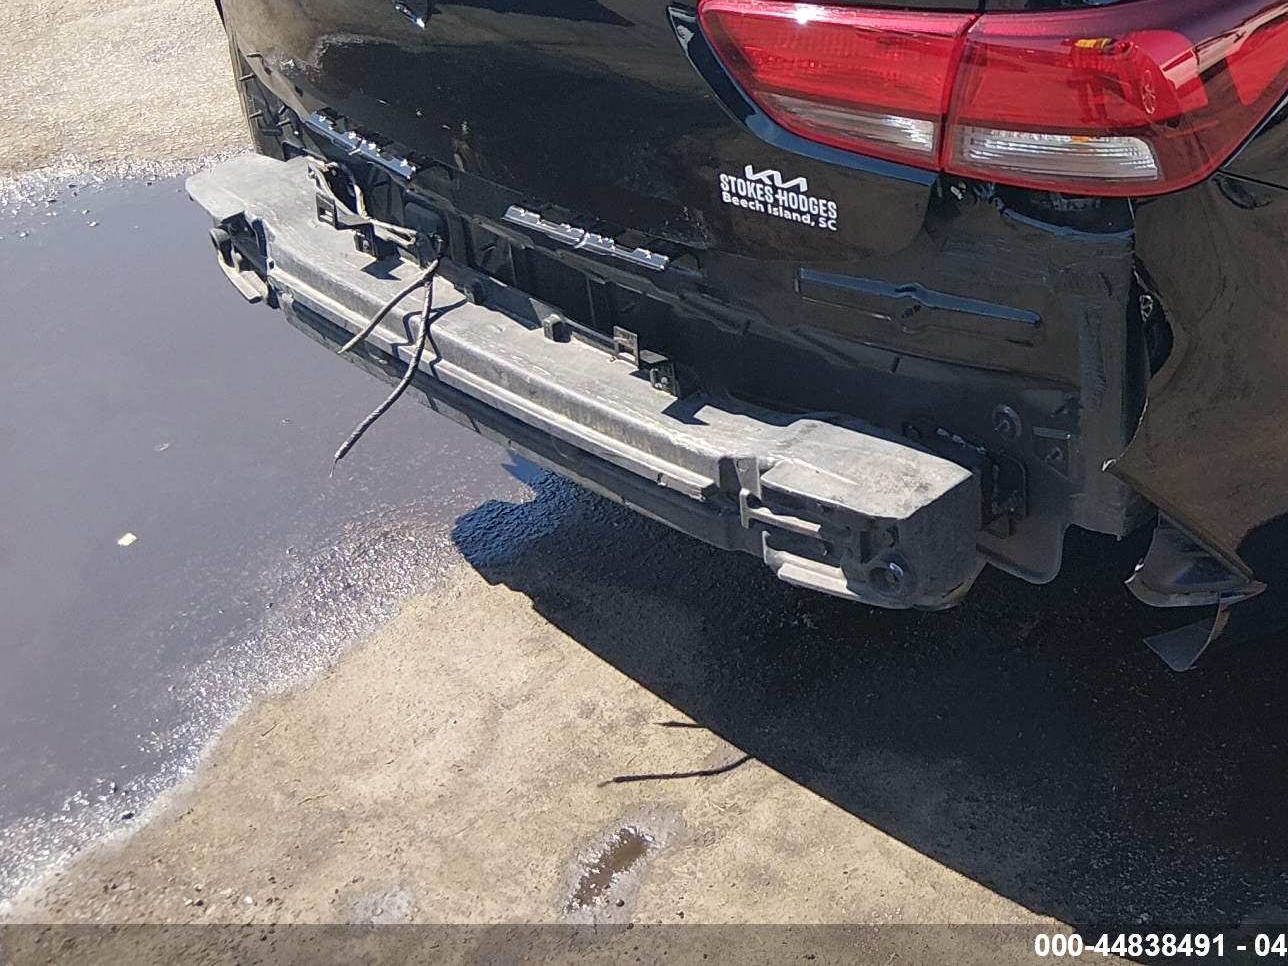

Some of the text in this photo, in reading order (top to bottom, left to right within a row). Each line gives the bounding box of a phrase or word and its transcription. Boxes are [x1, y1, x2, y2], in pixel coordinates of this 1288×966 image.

[744, 164, 808, 193] KIA
[722, 191, 837, 231] Beech Island, SC
